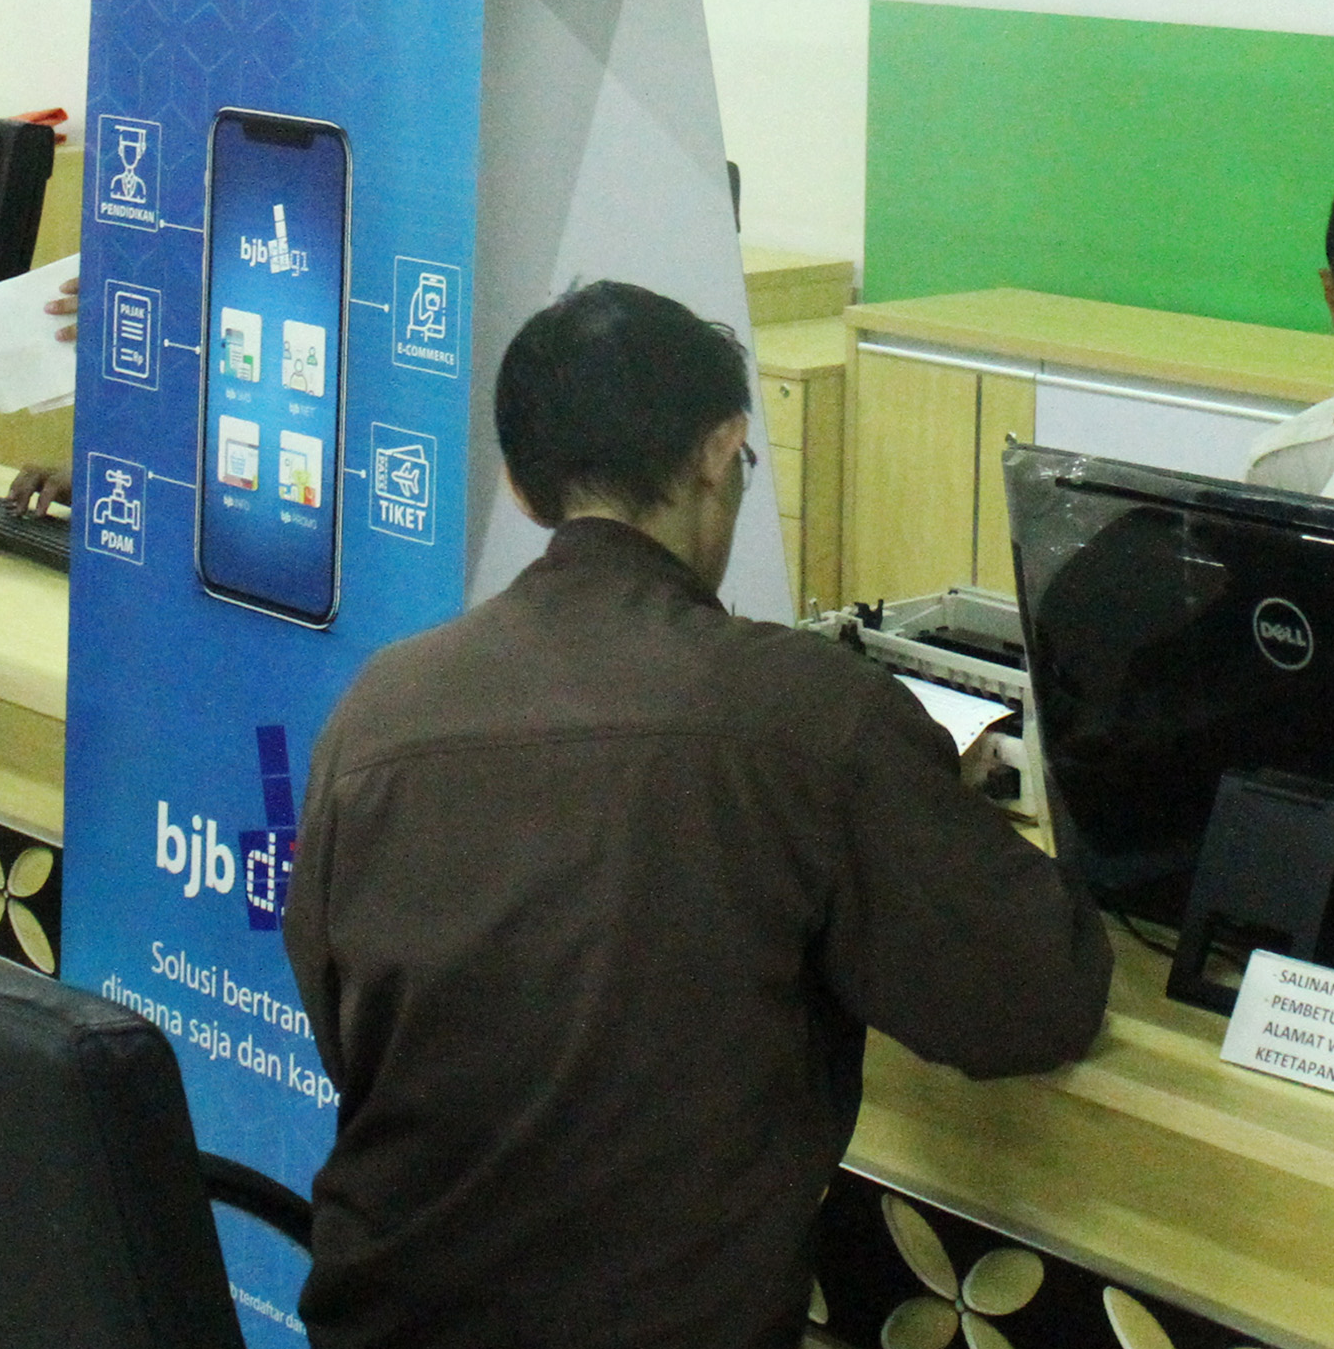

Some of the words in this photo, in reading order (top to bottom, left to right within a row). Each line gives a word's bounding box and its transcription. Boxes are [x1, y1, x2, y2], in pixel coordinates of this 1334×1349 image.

[100, 202, 155, 223] PENDIDIKAN
[241, 236, 268, 267] bjb
[120, 304, 145, 318] PAJAK
[397, 342, 455, 366] E-COMMERCE
[380, 500, 426, 531] TIKET
[101, 529, 134, 554] PDAM
[1260, 621, 1306, 647] DELL
[156, 800, 236, 898] bjb
[151, 941, 217, 998] Solusi
[223, 968, 315, 1041] bertran
[102, 973, 183, 1037] dimana
[189, 1018, 231, 1060] saja
[237, 1033, 282, 1082] dan
[1263, 1020, 1324, 1051] ALAMAT
[239, 1288, 285, 1323] terdaftar
